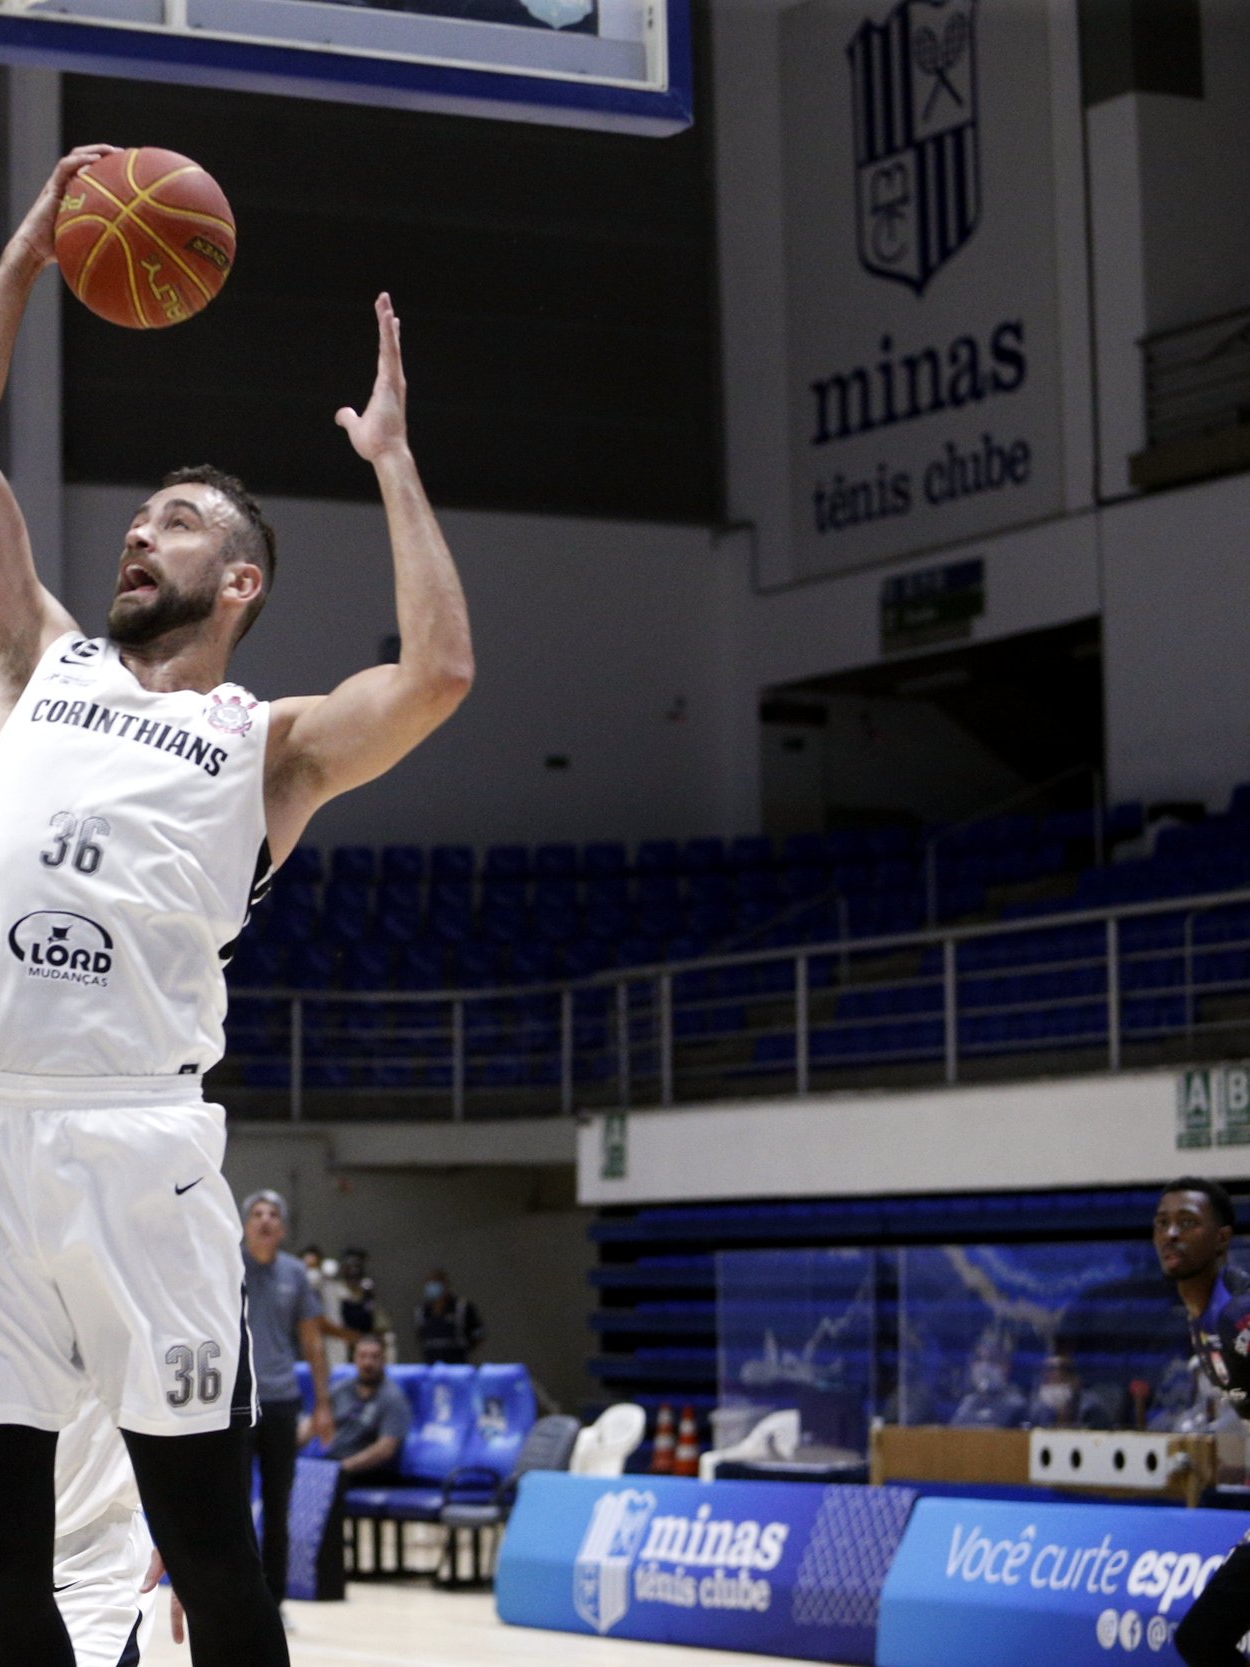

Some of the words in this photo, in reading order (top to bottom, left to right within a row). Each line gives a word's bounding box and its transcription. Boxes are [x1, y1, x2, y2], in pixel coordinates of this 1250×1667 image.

[810, 318, 1027, 446] minas
[813, 461, 912, 534] tênis
[923, 431, 1032, 506] clube
[31, 697, 228, 778] CORINTHIANS
[40, 810, 111, 875] 36
[28, 966, 108, 988] MUDANÇAS
[30, 942, 112, 975] LORD
[165, 1340, 222, 1409] 36
[639, 1503, 790, 1571] minas
[945, 1522, 1037, 1586] Você
[1029, 1533, 1130, 1596] curte
[634, 1561, 697, 1609] tênis
[699, 1565, 772, 1613] clube
